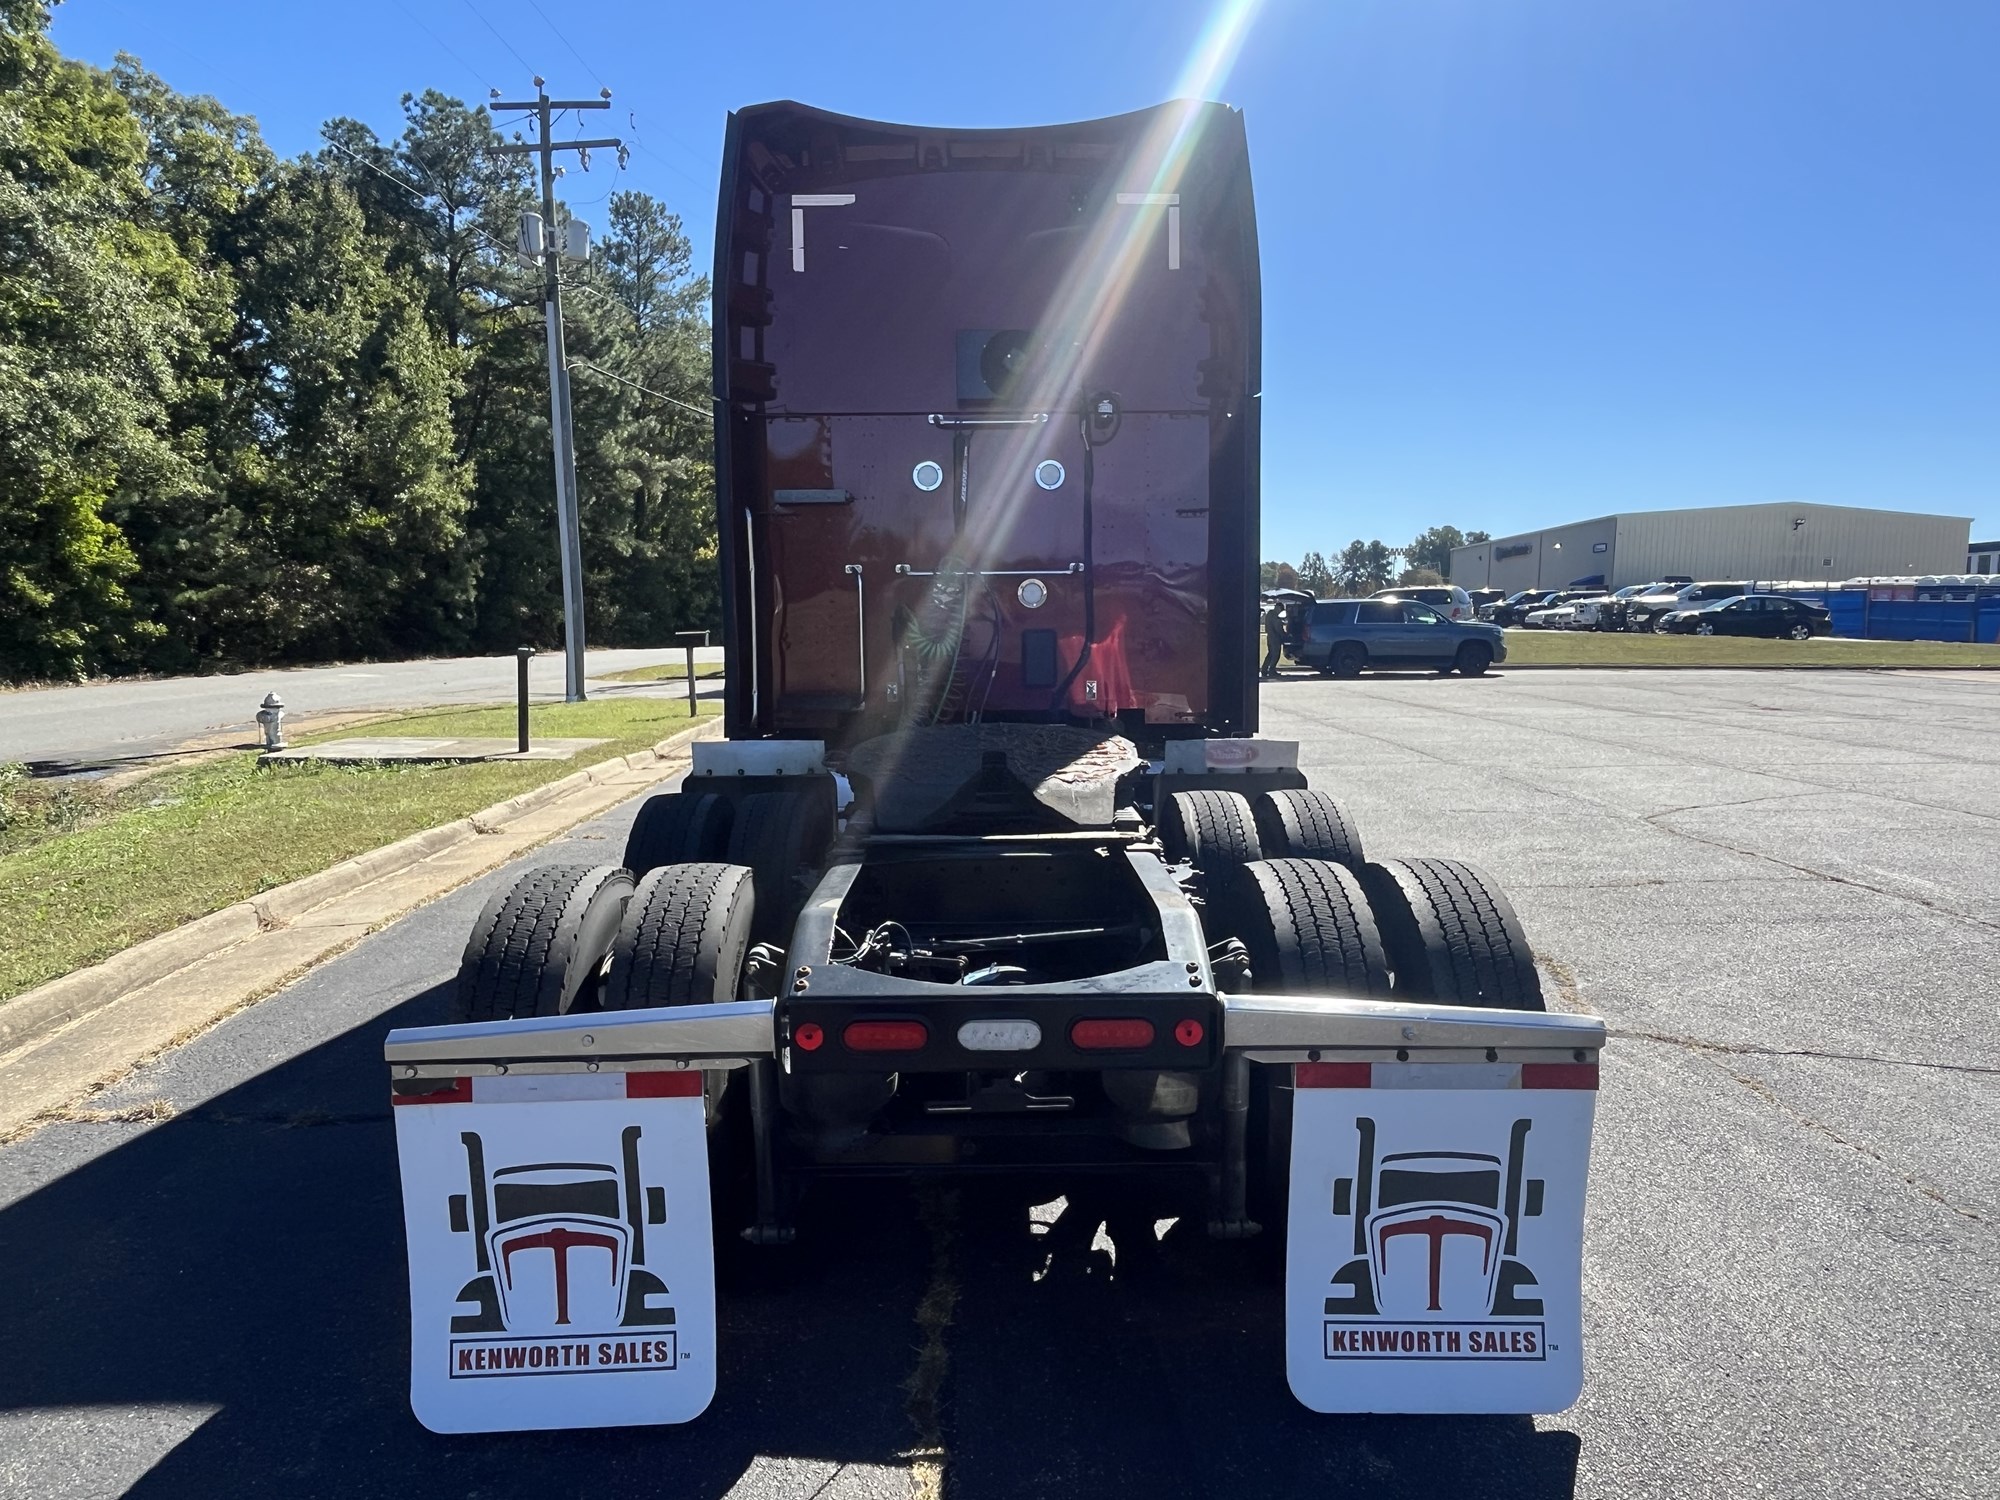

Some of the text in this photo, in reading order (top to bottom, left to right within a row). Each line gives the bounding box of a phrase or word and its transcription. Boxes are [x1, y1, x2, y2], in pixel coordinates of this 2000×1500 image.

[1332, 1330, 1461, 1353] KENWORTH
[1468, 1330, 1537, 1353] SALES
[458, 1344, 590, 1371] KENWORTH
[598, 1340, 668, 1365] SALES
